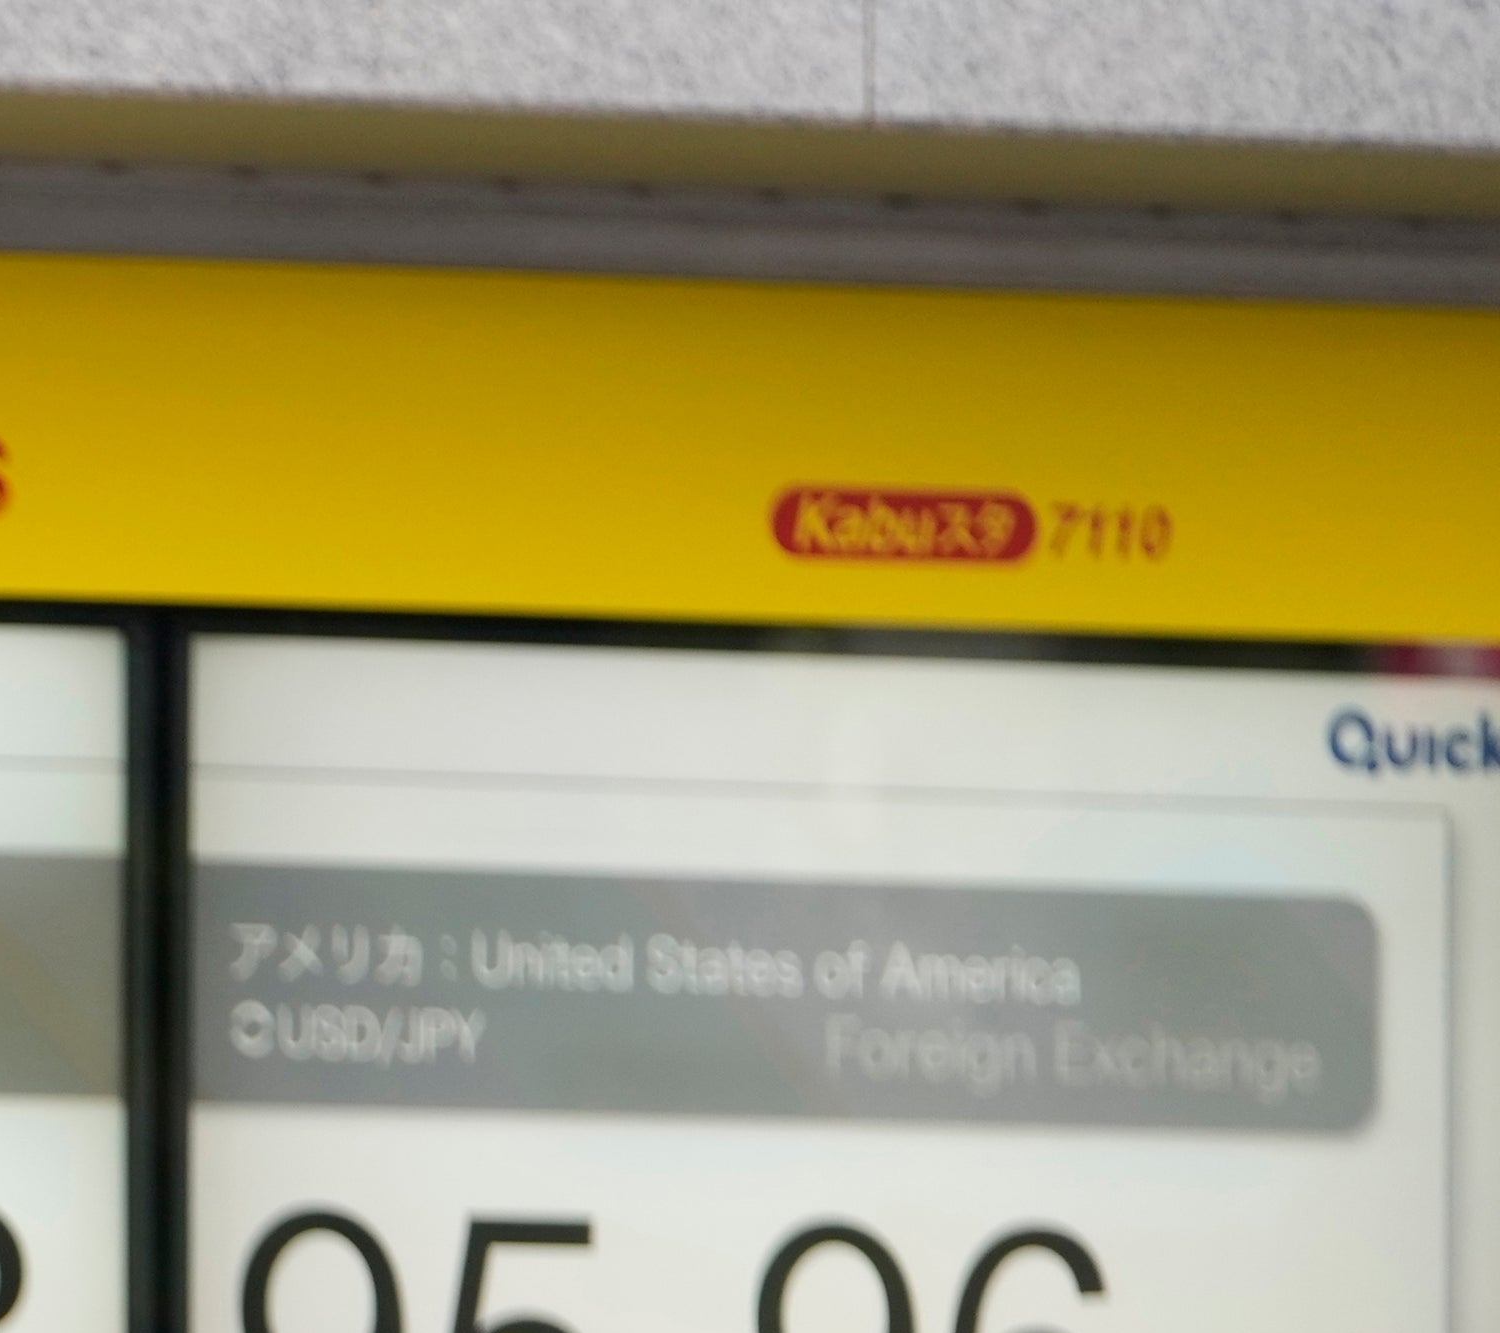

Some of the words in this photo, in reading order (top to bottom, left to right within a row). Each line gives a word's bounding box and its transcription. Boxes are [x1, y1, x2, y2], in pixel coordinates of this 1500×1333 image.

[471, 928, 634, 992] United
[645, 932, 802, 999] States
[880, 940, 1080, 1005] America
